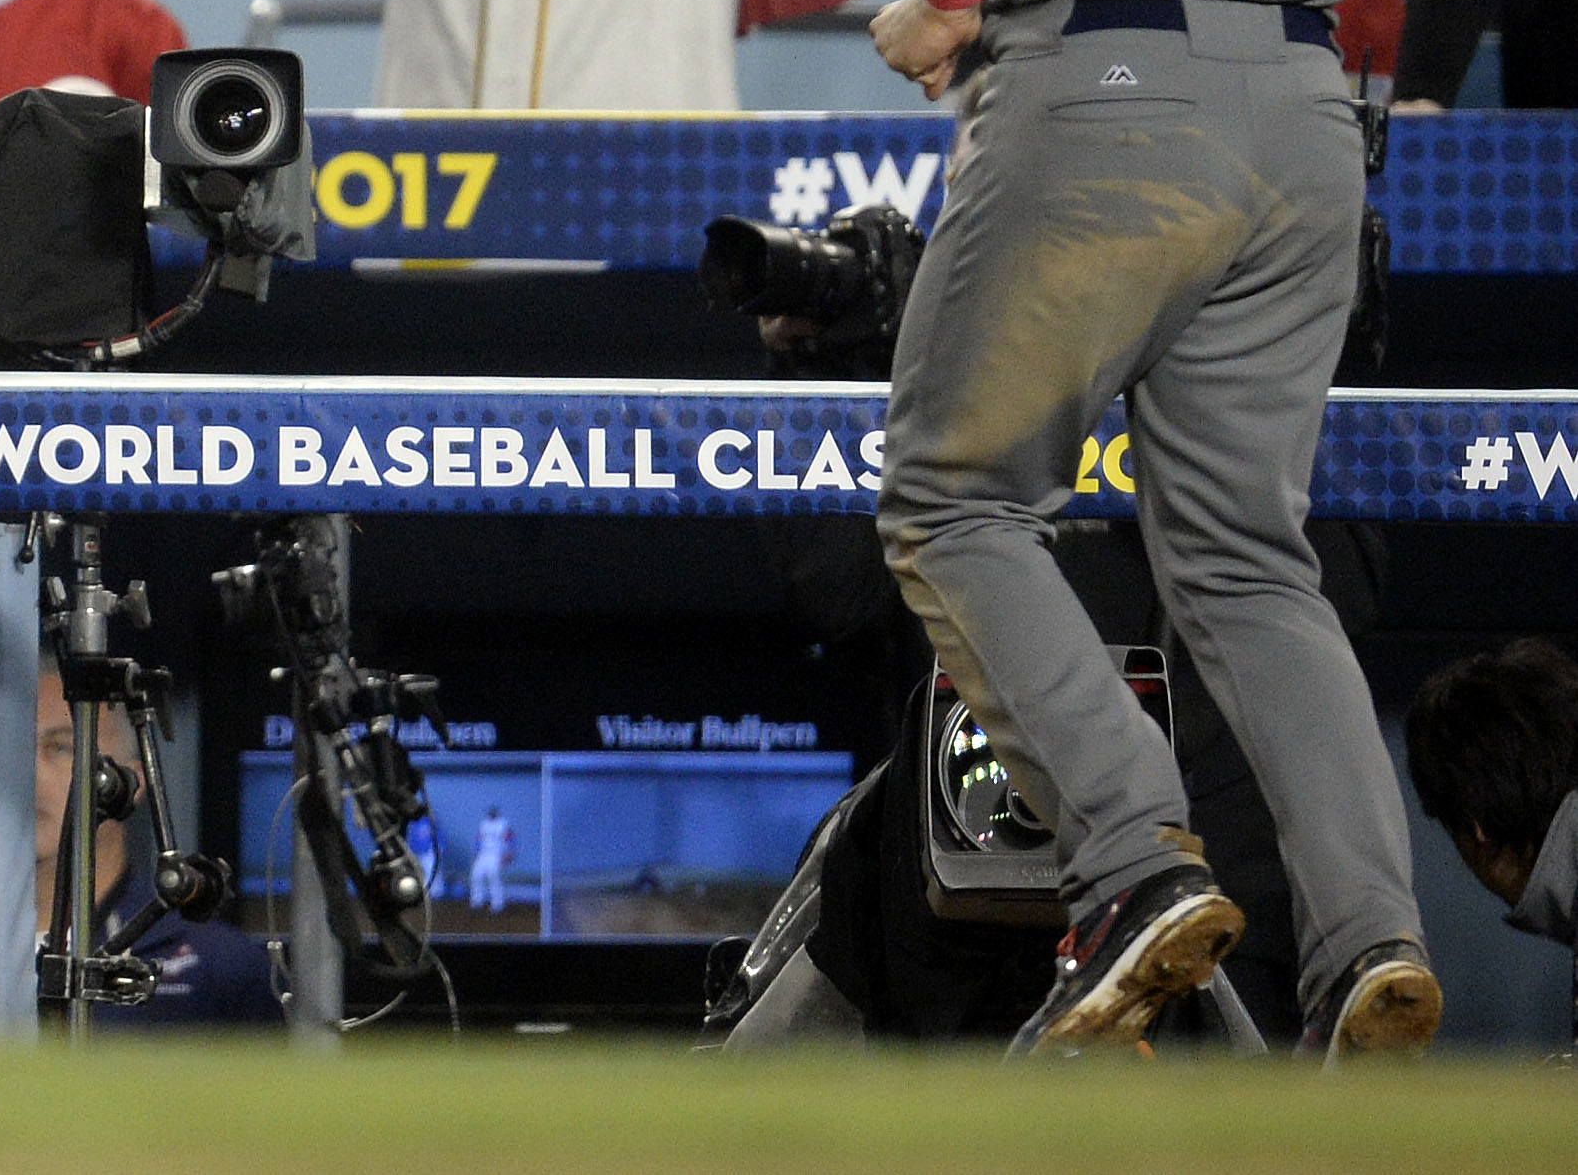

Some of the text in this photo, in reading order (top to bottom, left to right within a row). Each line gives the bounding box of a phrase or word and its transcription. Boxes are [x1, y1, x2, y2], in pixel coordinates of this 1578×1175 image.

[311, 149, 499, 230] 017
[769, 151, 943, 227] #W
[278, 425, 677, 489] BASEBALL
[697, 428, 887, 491] CLAS
[1074, 432, 1136, 494] 20
[597, 714, 696, 748] Visitor
[701, 714, 818, 753] Bullpen
